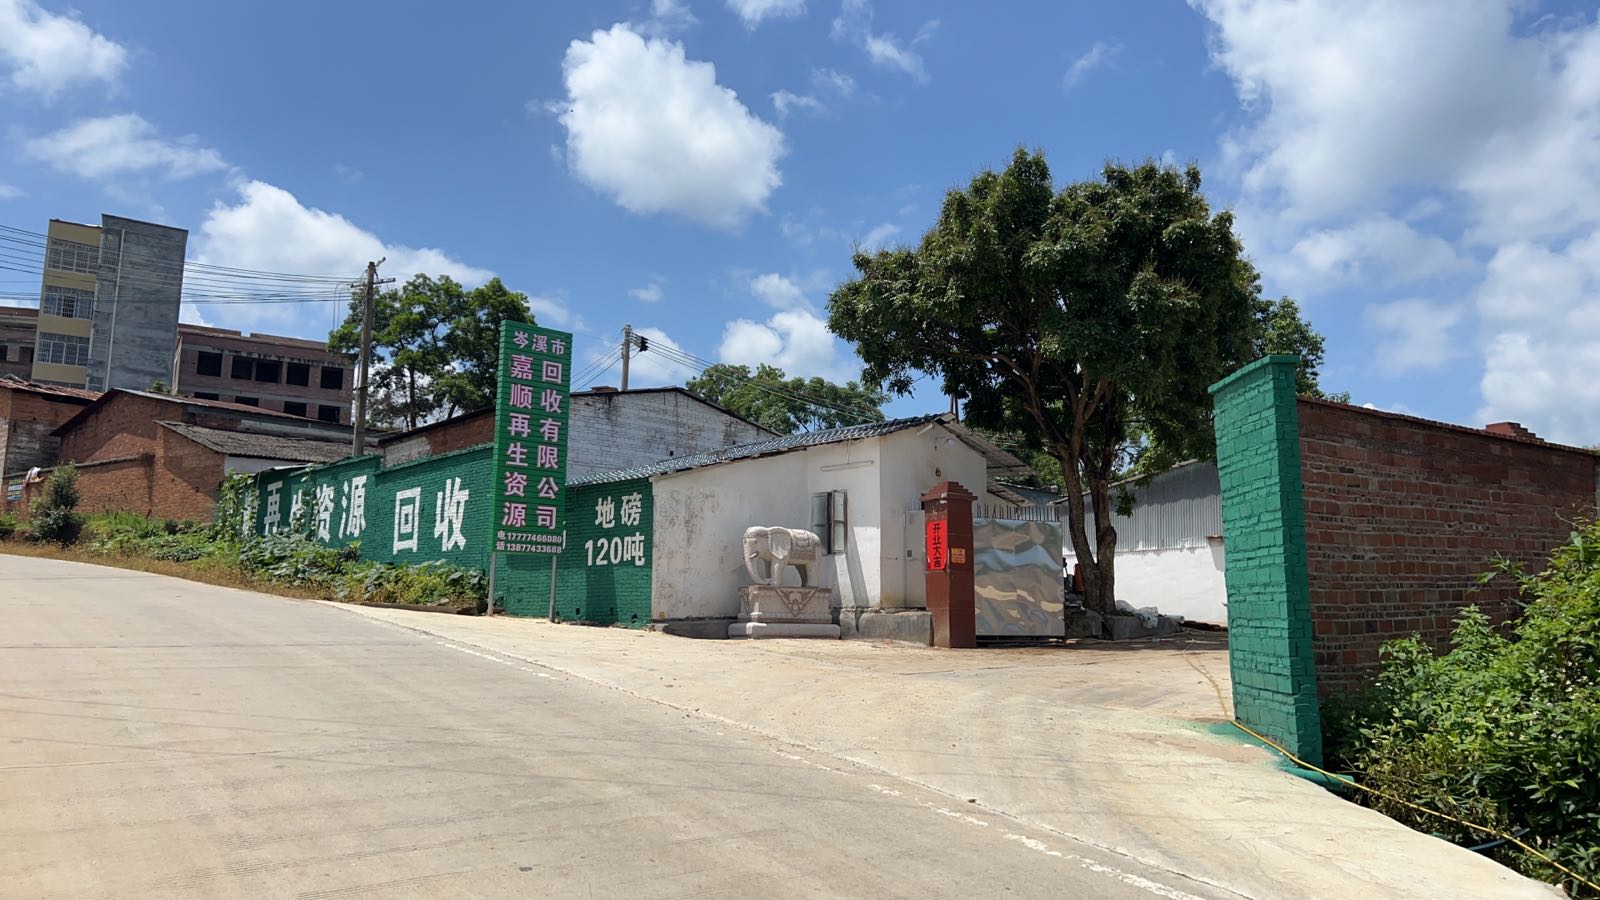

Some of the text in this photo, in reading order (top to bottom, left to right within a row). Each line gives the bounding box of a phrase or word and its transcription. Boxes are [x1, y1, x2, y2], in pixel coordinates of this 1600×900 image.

[512, 330, 566, 356] 岑溪市
[502, 354, 534, 528] 嘉顺再生资源
[536, 360, 563, 530] 回收有限公司
[595, 491, 642, 529] 地磅
[584, 532, 646, 567] 120吨
[932, 522, 942, 568] 开业大吉
